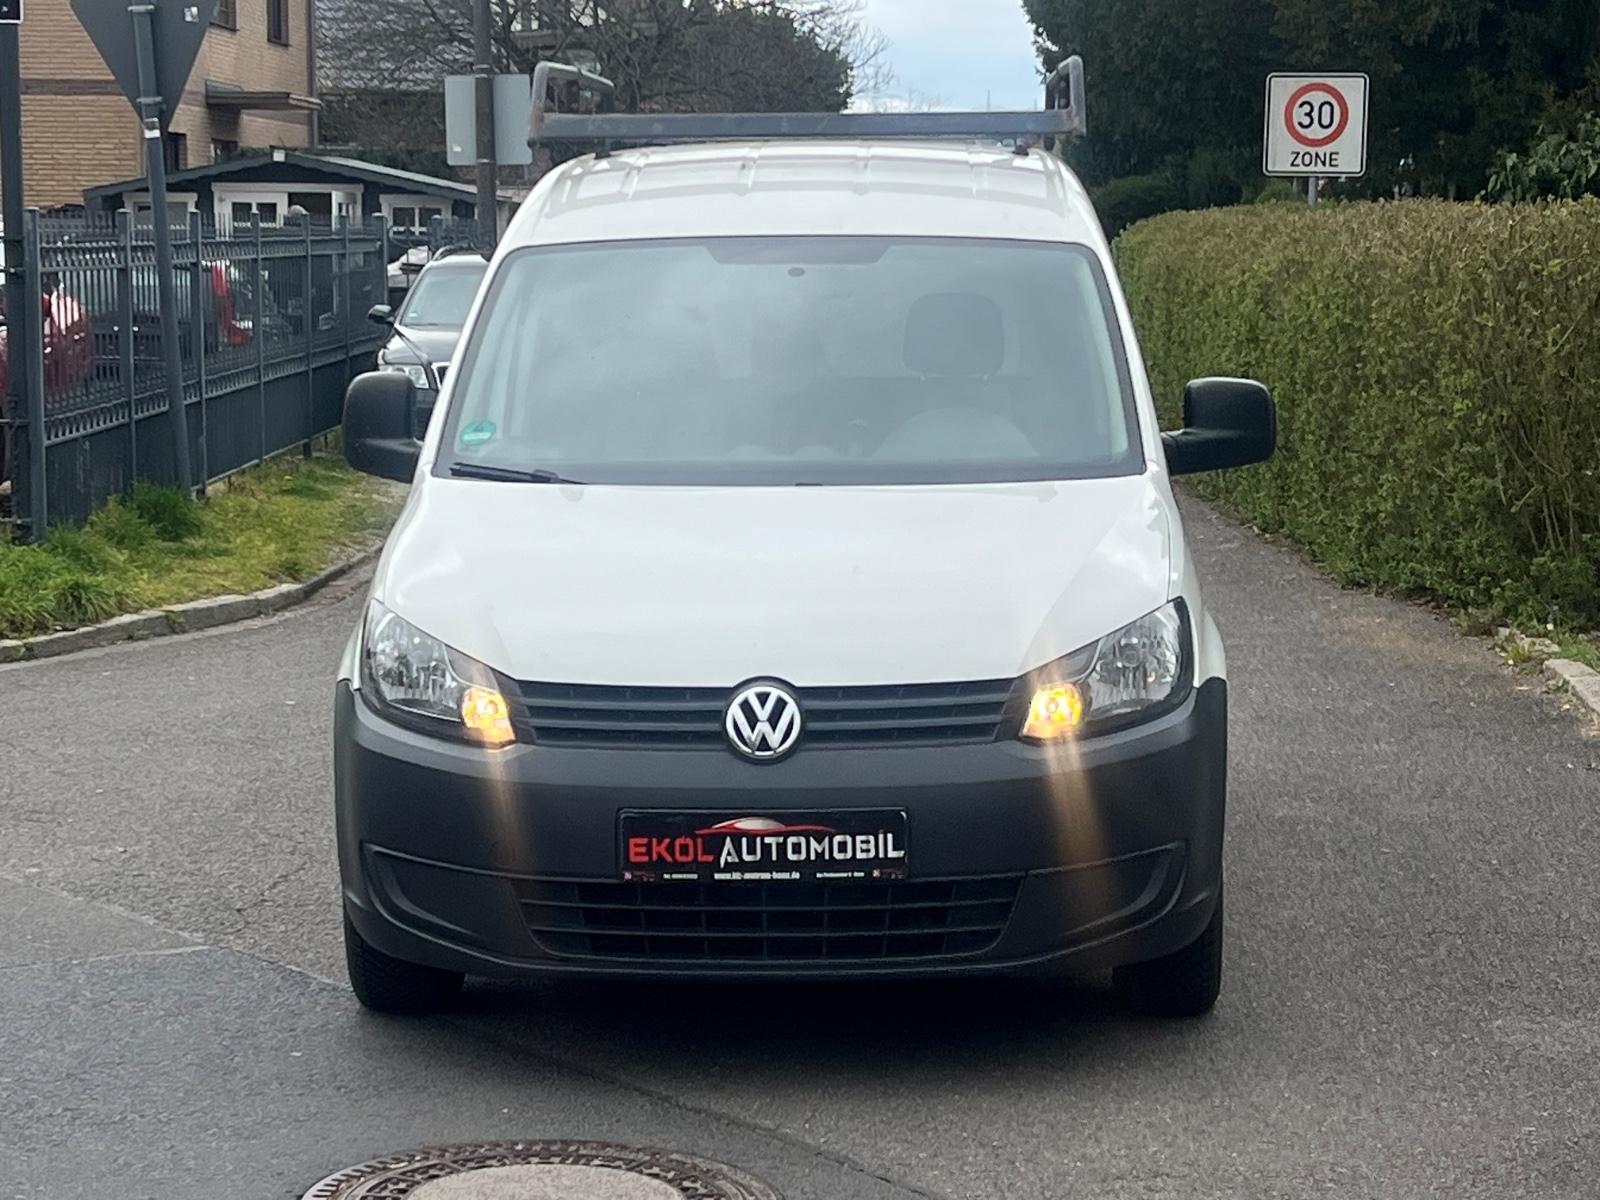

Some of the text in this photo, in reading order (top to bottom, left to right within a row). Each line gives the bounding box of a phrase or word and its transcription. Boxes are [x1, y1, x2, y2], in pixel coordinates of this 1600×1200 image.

[1297, 101, 1335, 129] 30
[1290, 151, 1340, 168] ZONE
[728, 688, 798, 754] VW
[628, 836, 715, 863] EKOL
